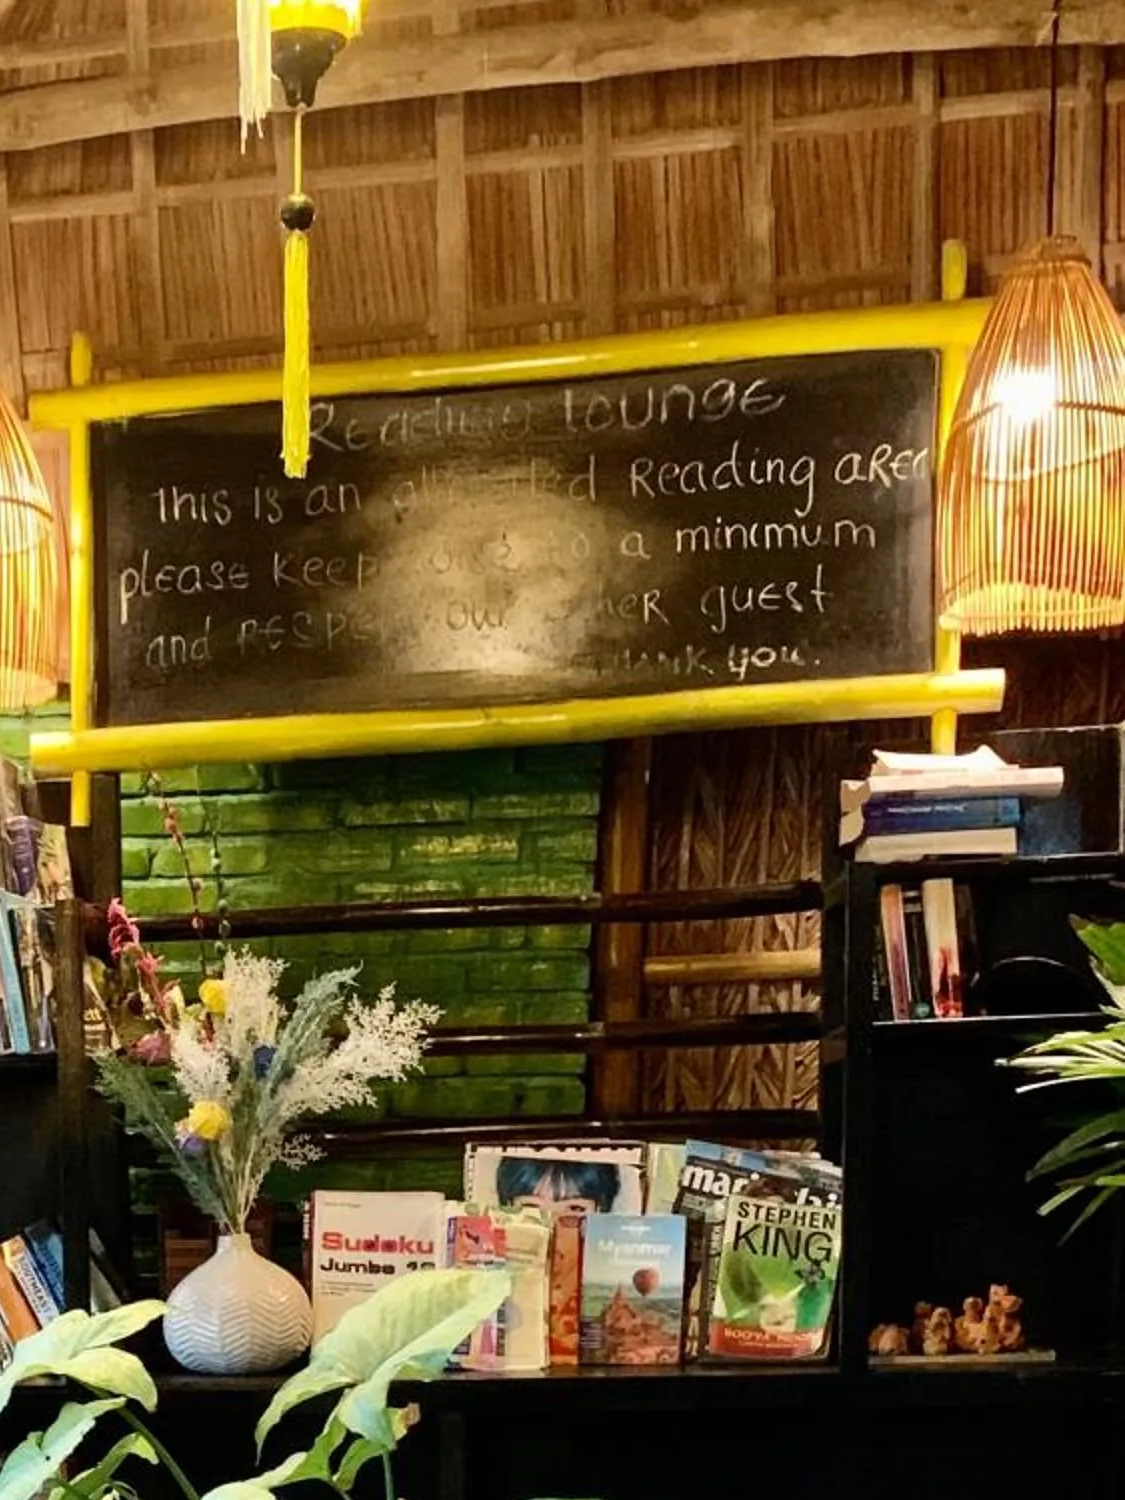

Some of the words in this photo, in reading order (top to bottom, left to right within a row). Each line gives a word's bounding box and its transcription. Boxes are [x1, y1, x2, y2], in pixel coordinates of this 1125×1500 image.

[254, 484, 284, 525] is
[305, 482, 362, 517] an
[631, 440, 815, 517] Reading
[620, 531, 652, 559] a
[676, 516, 876, 556] minimum
[146, 615, 212, 668] and
[737, 1201, 836, 1231] STEPHEN
[321, 1231, 434, 1255] Sudoku
[733, 1220, 834, 1265] KING
[320, 1257, 395, 1276] Jumbo
